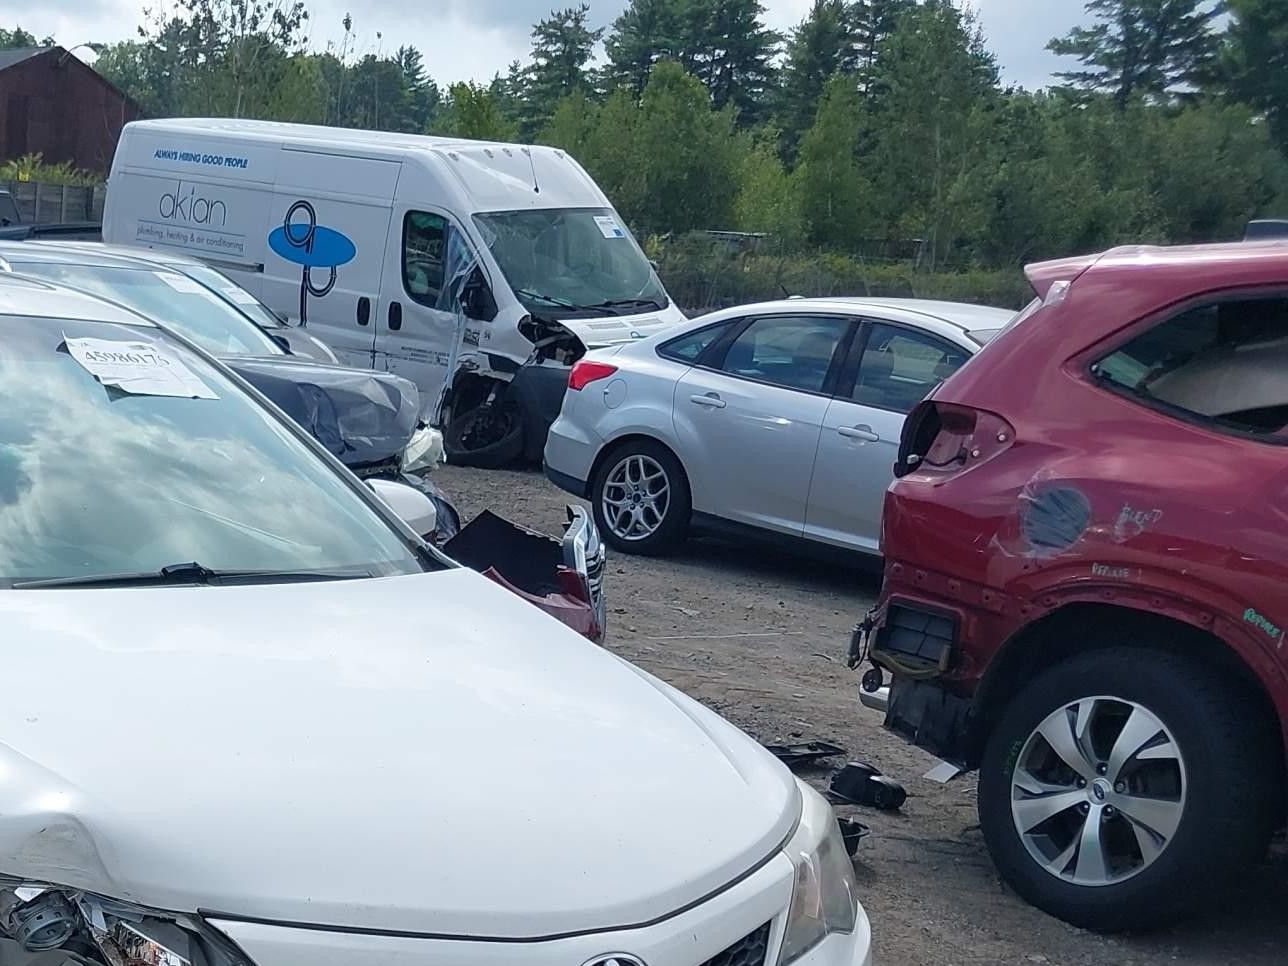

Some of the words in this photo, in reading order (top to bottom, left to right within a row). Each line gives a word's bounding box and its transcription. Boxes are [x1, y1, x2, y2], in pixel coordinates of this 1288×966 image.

[154, 149, 178, 160] ALWAYS
[178, 152, 201, 163] HIRING
[202, 154, 223, 166] GOOD
[224, 157, 248, 168] PEOPLE
[159, 179, 226, 226] akian
[206, 237, 244, 252] conditioning
